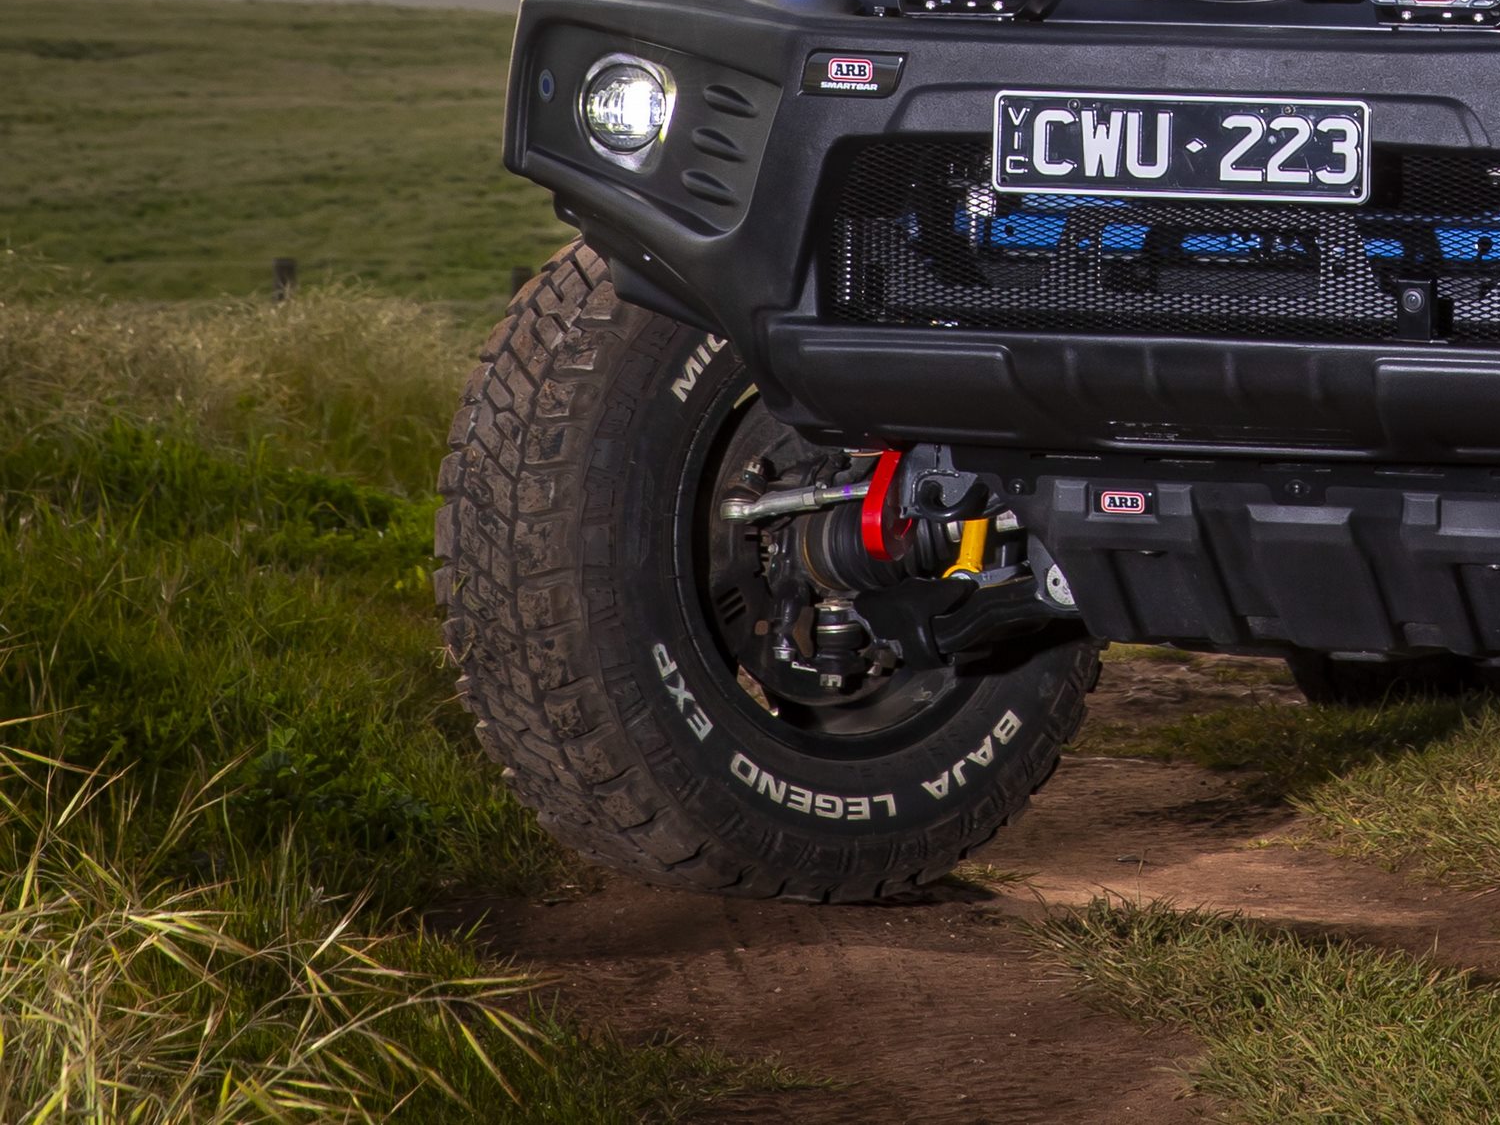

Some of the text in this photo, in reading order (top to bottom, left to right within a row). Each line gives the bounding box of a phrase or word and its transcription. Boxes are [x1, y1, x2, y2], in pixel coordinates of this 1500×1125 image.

[820, 81, 878, 92] SMARTBAR
[834, 63, 867, 77] ARB
[1006, 106, 1030, 174] VIC
[1033, 109, 1361, 185] CWU 223
[1106, 496, 1140, 509] ARB
[652, 642, 1024, 821] BAJA LEGEND EXP
